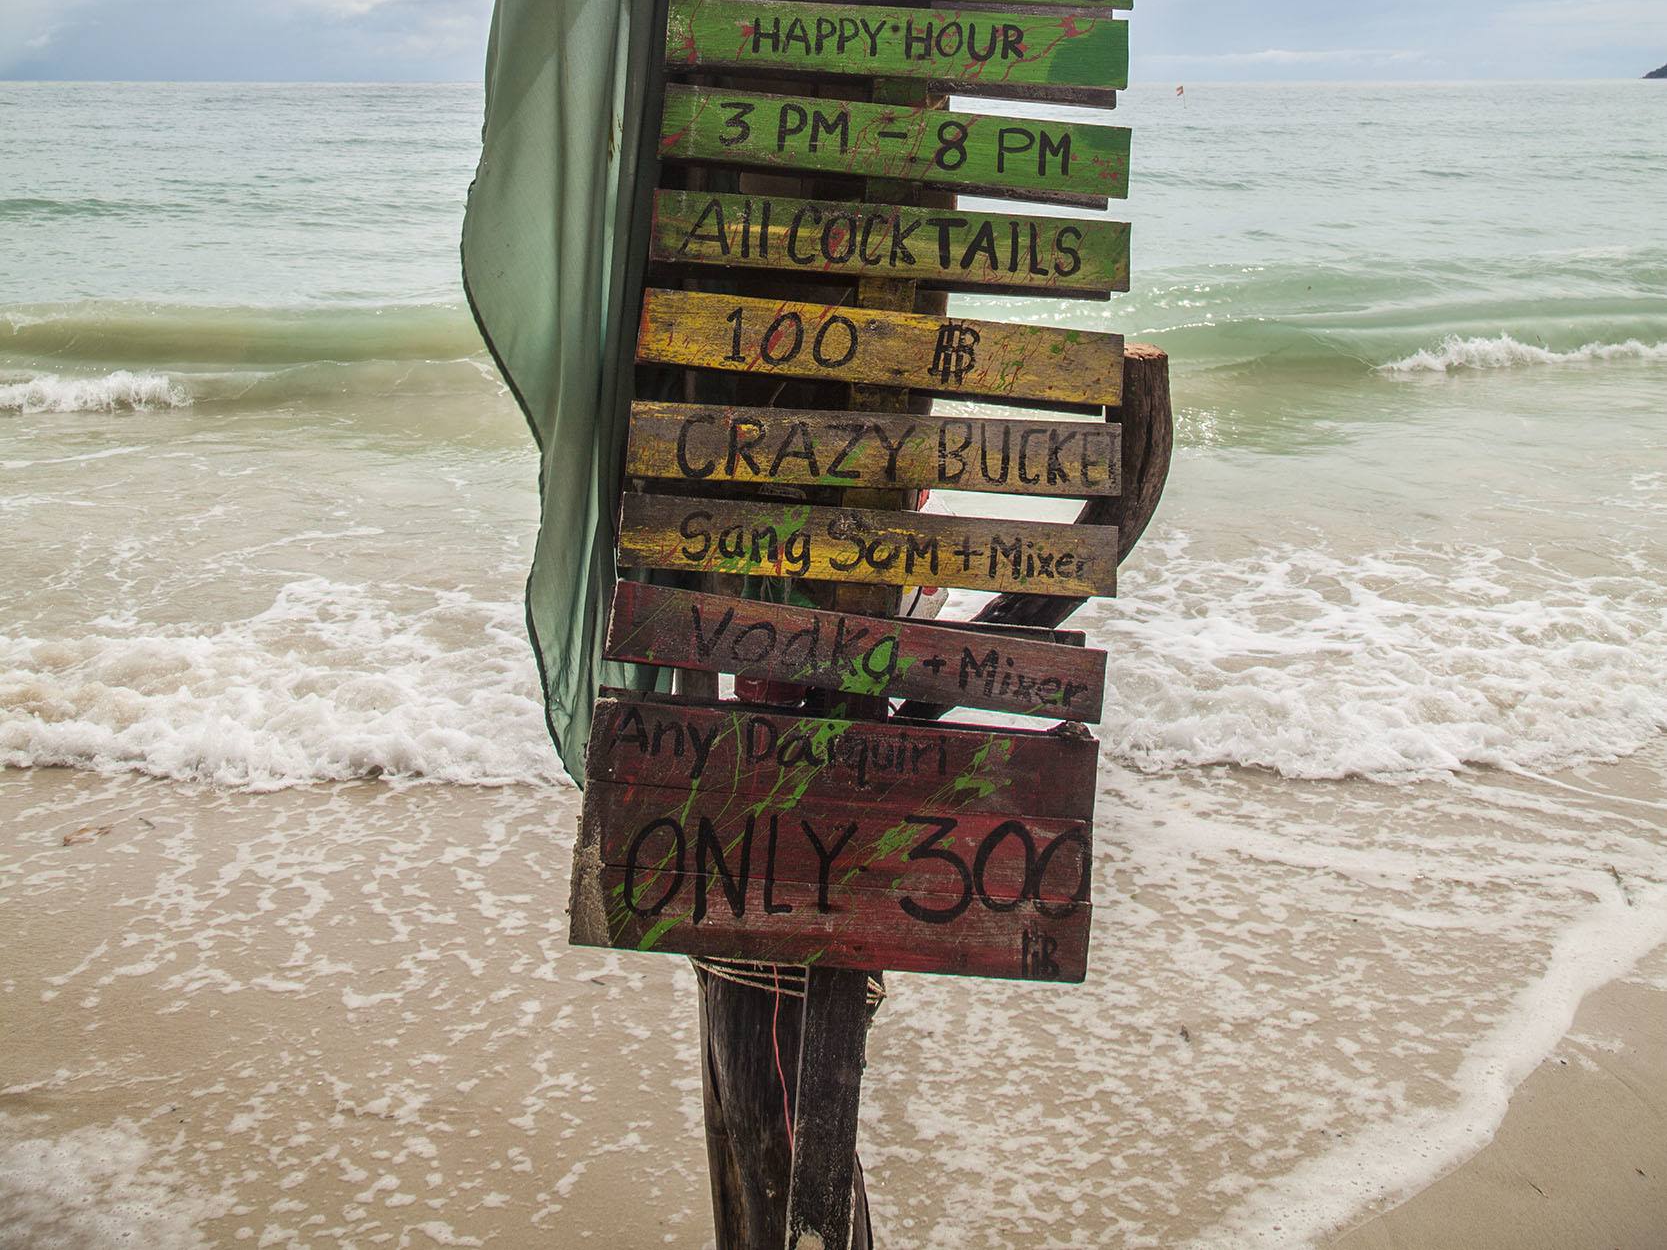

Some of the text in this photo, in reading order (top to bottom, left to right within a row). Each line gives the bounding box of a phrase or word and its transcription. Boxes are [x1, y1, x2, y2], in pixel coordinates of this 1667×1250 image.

[751, 16, 1025, 62] HAPPY HOUR
[719, 101, 755, 147] 3
[777, 103, 850, 154] PM
[935, 120, 969, 172] 8
[997, 126, 1072, 177] PM
[723, 306, 859, 369] 100
[677, 414, 916, 487] CRAZY
[681, 510, 812, 577] Sang
[988, 533, 1086, 581] Mixer
[691, 604, 901, 681] Vodka
[958, 646, 1088, 708] Mixer
[608, 706, 717, 781] Any
[623, 814, 1092, 925] ONLY 300
